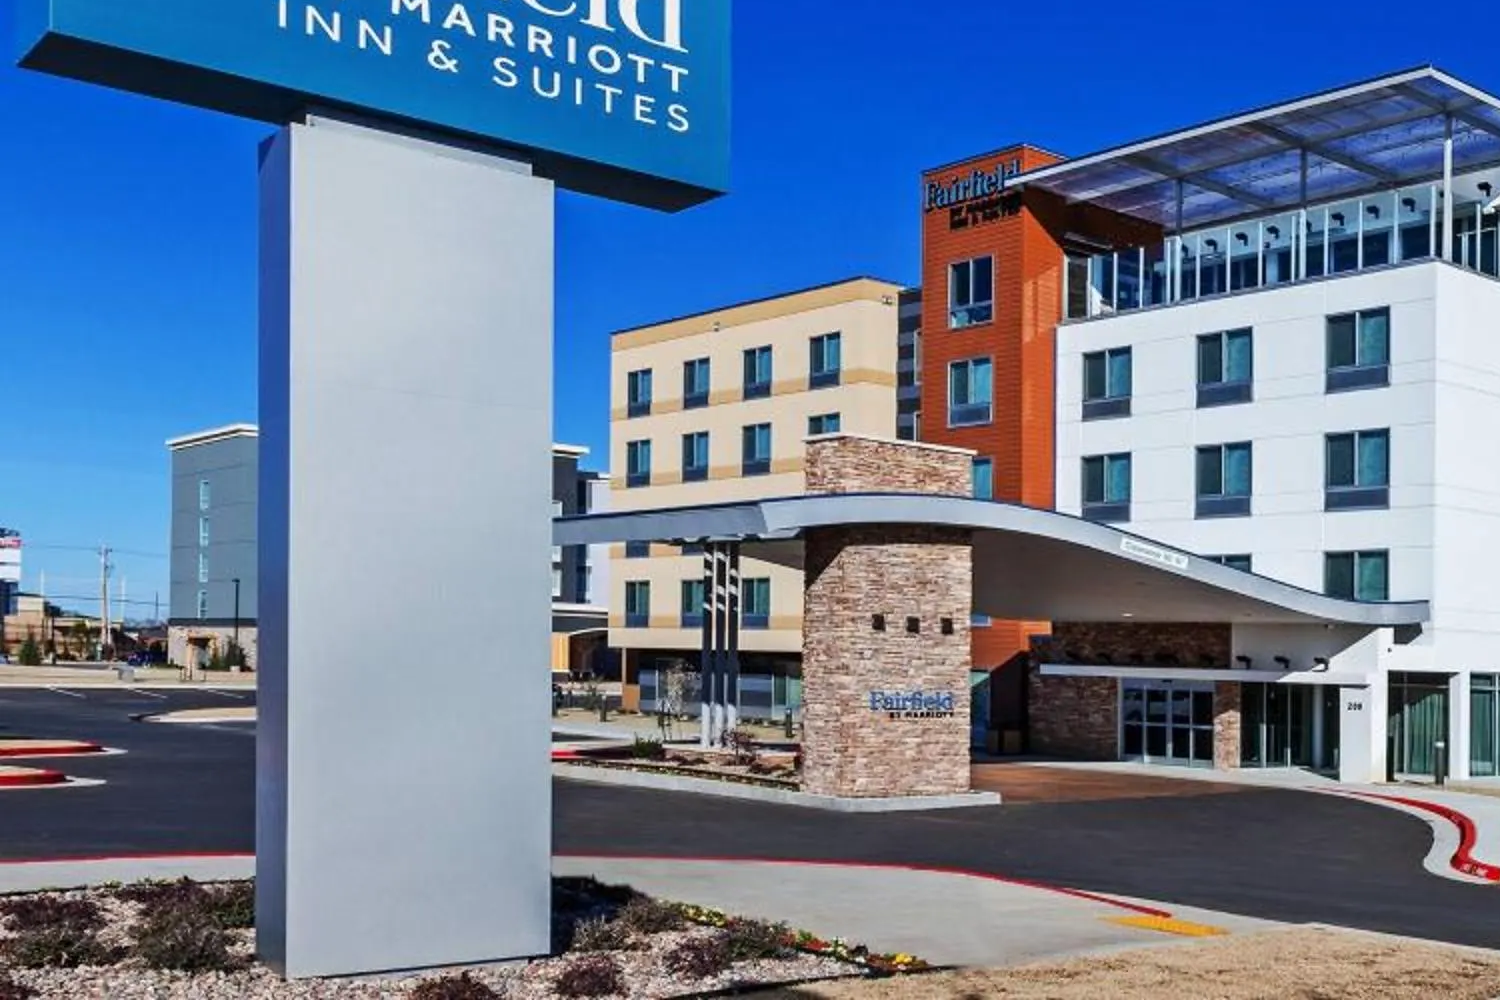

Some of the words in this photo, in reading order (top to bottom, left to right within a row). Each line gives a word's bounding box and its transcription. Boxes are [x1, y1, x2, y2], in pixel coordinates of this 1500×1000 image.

[427, 40, 459, 73] &
[493, 57, 690, 133] SUITES
[869, 690, 954, 711] Fairfield
